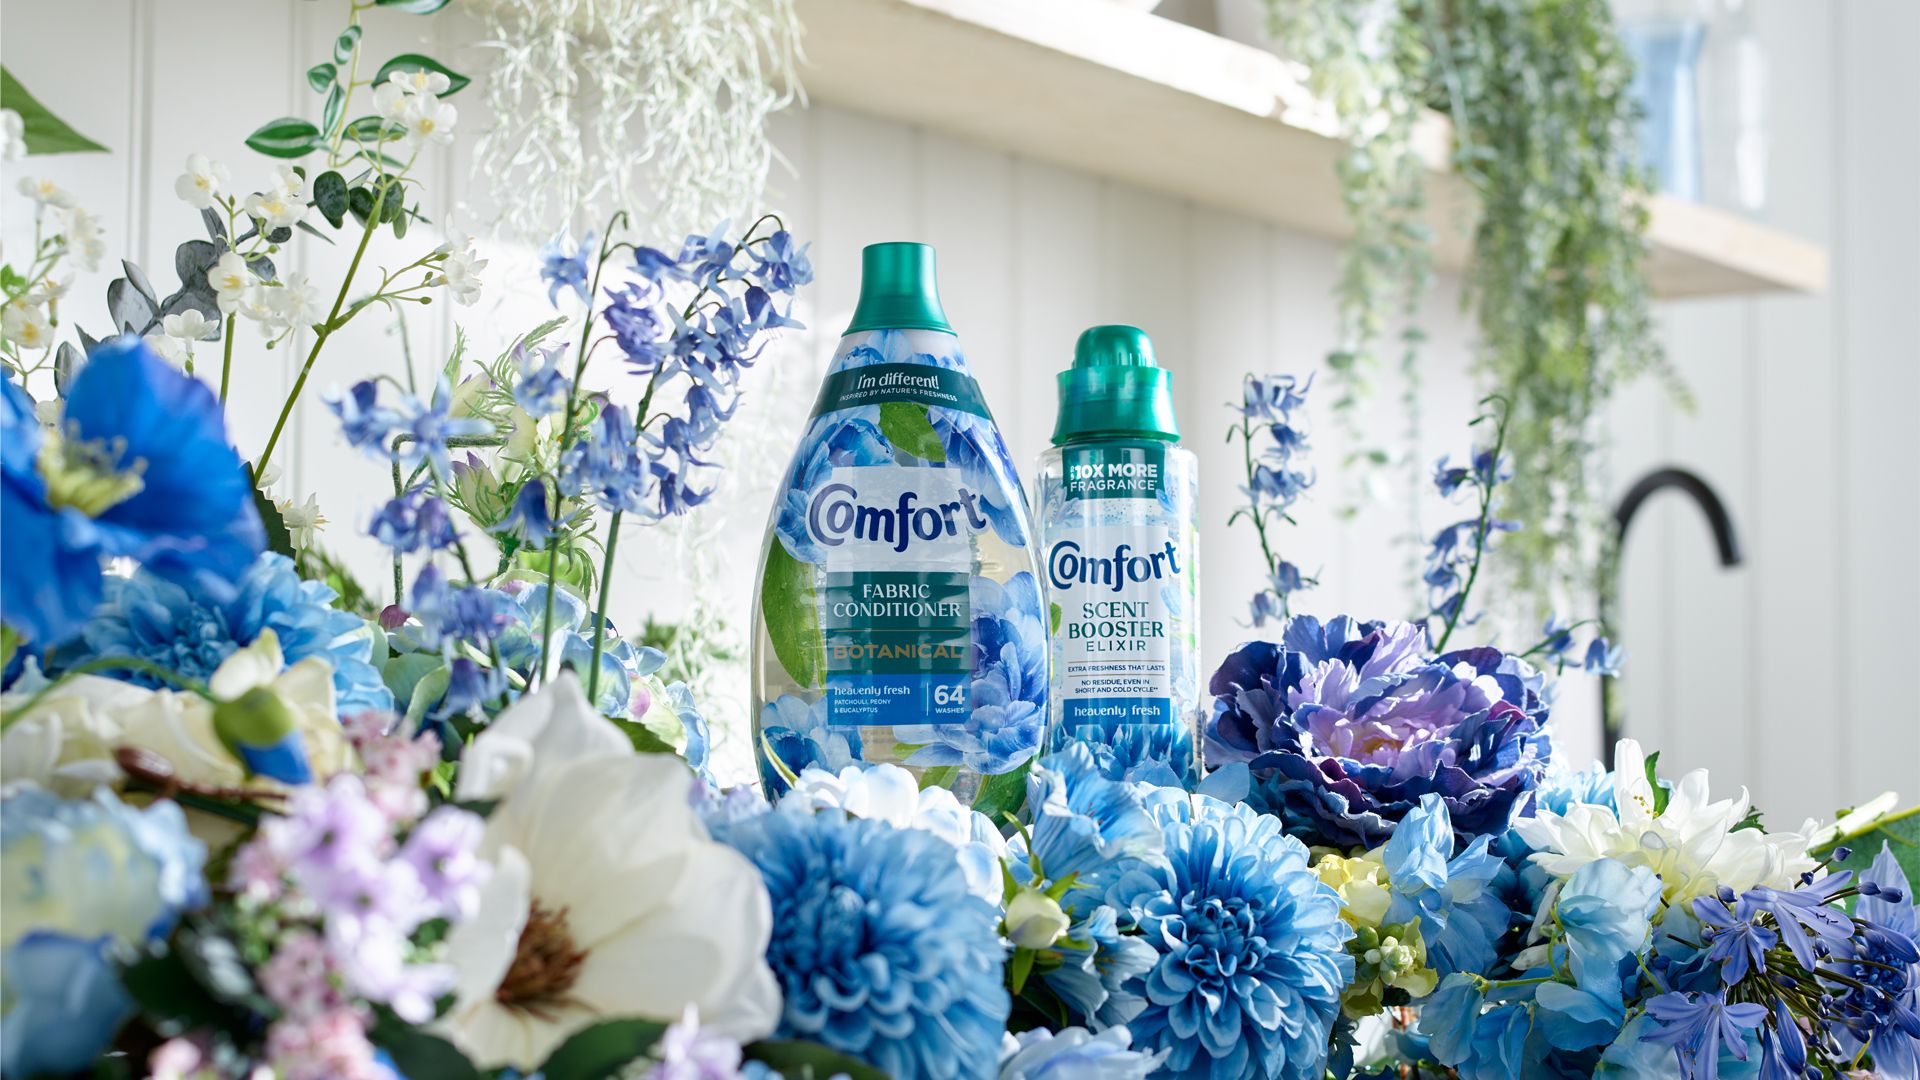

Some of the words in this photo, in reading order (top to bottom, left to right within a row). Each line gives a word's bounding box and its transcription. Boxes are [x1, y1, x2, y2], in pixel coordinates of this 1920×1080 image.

[858, 374, 876, 389] I'm
[879, 372, 939, 389] different!
[839, 391, 867, 401] INSPIRED
[869, 389, 878, 397] BY
[880, 387, 917, 395] NATURE'S
[919, 389, 958, 402] FRESHNESS
[1075, 463, 1105, 479] 10X
[1108, 463, 1158, 478] MORE
[809, 483, 986, 552] Comfort
[1048, 540, 1181, 593] Comfort
[863, 584, 930, 598] FABRIC
[833, 602, 961, 617] CONDITIONER
[1082, 601, 1149, 619] SCENT
[1068, 621, 1164, 639] BOOSTER
[833, 644, 963, 659] BOTANICAL
[1086, 640, 1146, 652] ELIXIR
[834, 686, 881, 697] heavenly
[883, 686, 910, 695] fresh
[934, 685, 965, 705] 64
[1074, 706, 1126, 717] heavenly
[1131, 705, 1161, 716] fresh
